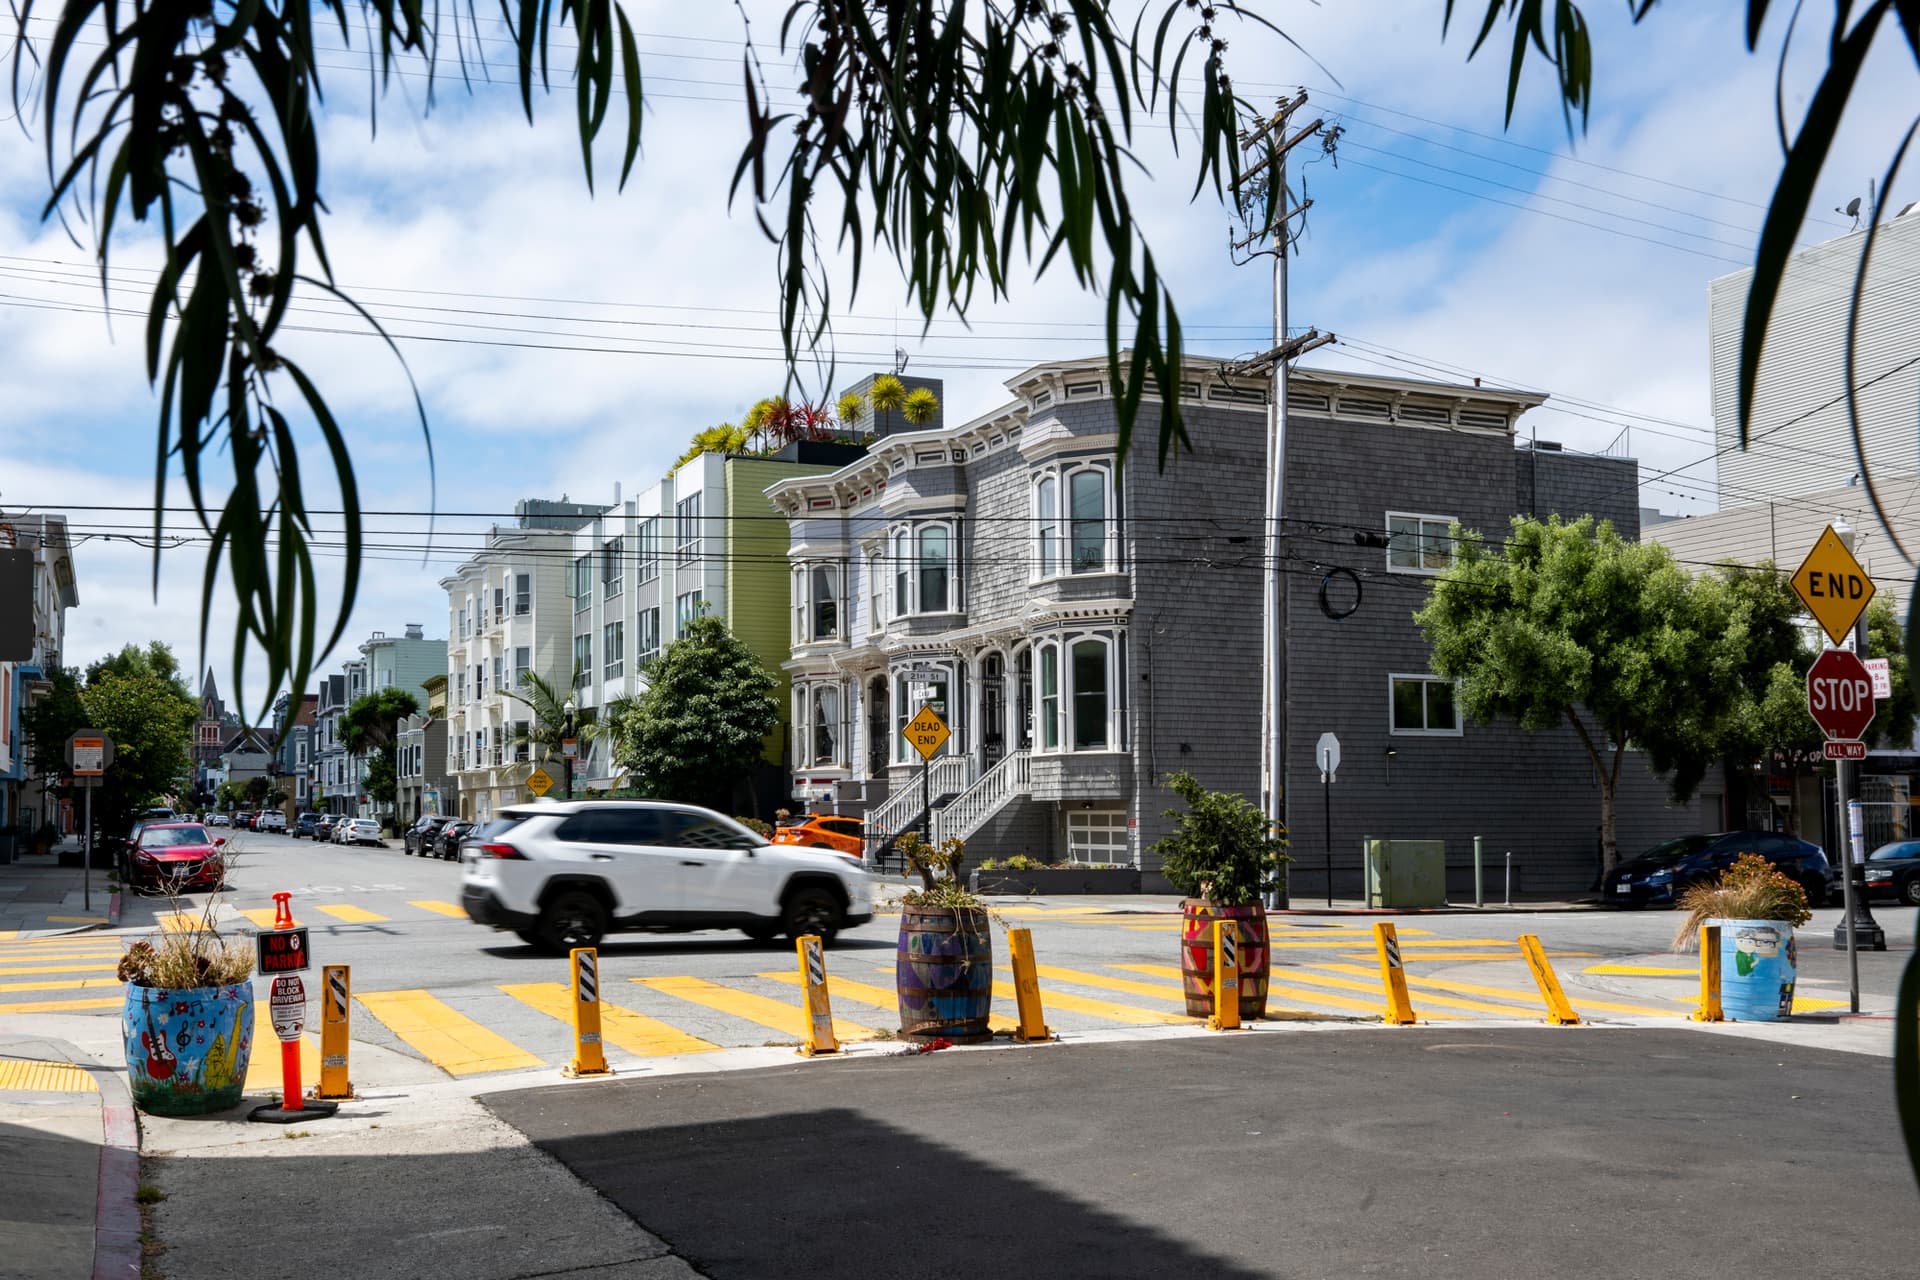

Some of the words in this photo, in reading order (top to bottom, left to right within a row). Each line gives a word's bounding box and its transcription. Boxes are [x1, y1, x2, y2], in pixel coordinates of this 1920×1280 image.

[1809, 571, 1864, 600] END
[1812, 677, 1870, 712] STOP
[914, 722, 940, 732] DEAD
[917, 735, 937, 745] END
[1827, 745, 1843, 757] ALL
[1846, 745, 1863, 757] WAY
[269, 936, 286, 953] NO
[264, 951, 305, 972] PARKING
[276, 979, 287, 988] DO
[288, 978, 300, 986] NOT
[277, 986, 300, 996] BLOCK
[271, 993, 304, 1004] DRIVEWAY
